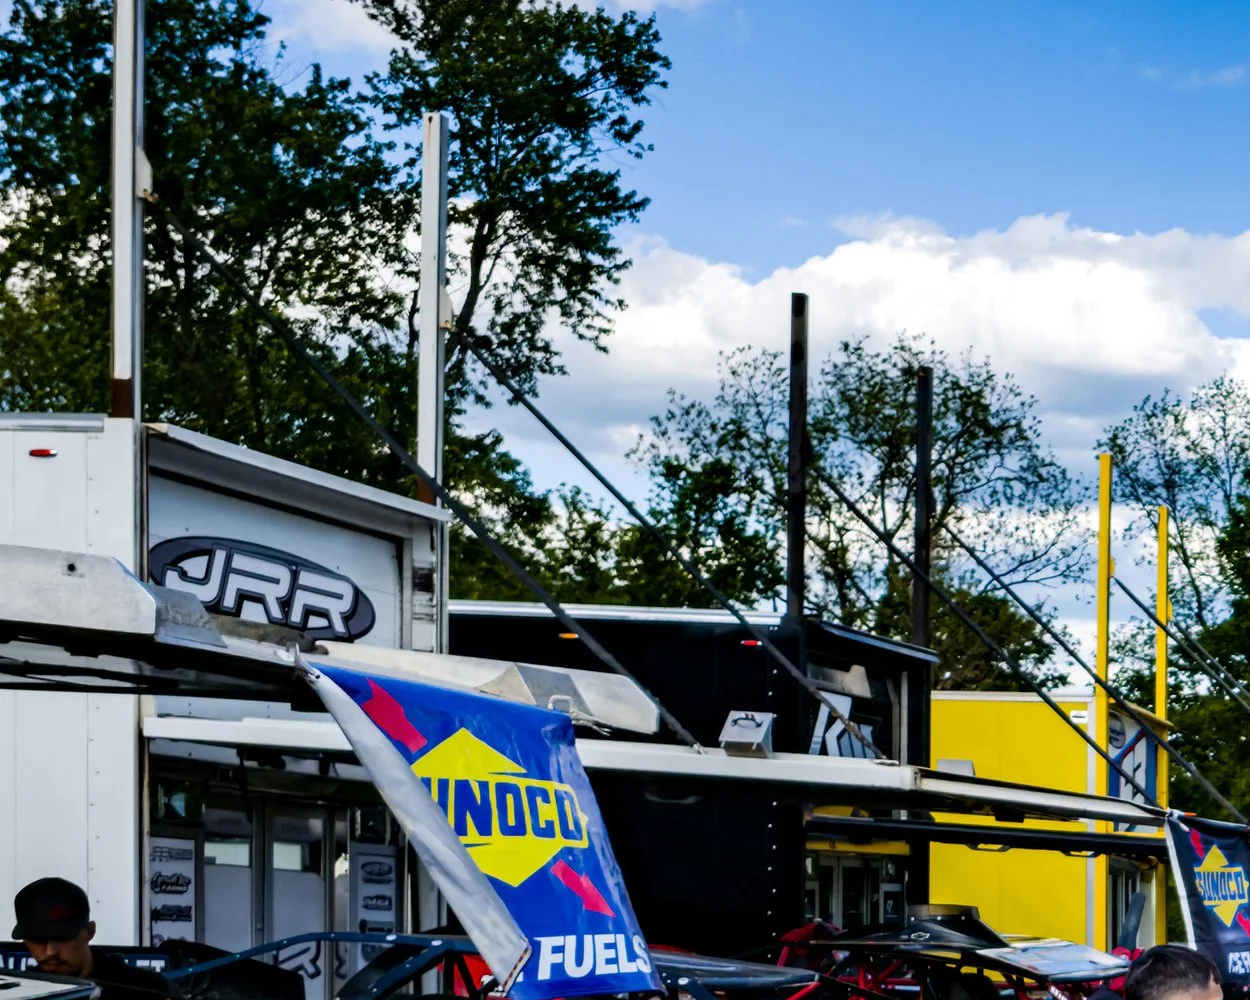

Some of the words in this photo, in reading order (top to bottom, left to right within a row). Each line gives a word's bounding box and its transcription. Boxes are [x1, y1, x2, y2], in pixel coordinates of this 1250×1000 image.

[164, 548, 354, 634] JRR
[420, 776, 584, 842] UNOCO
[533, 933, 652, 981] FUELS
